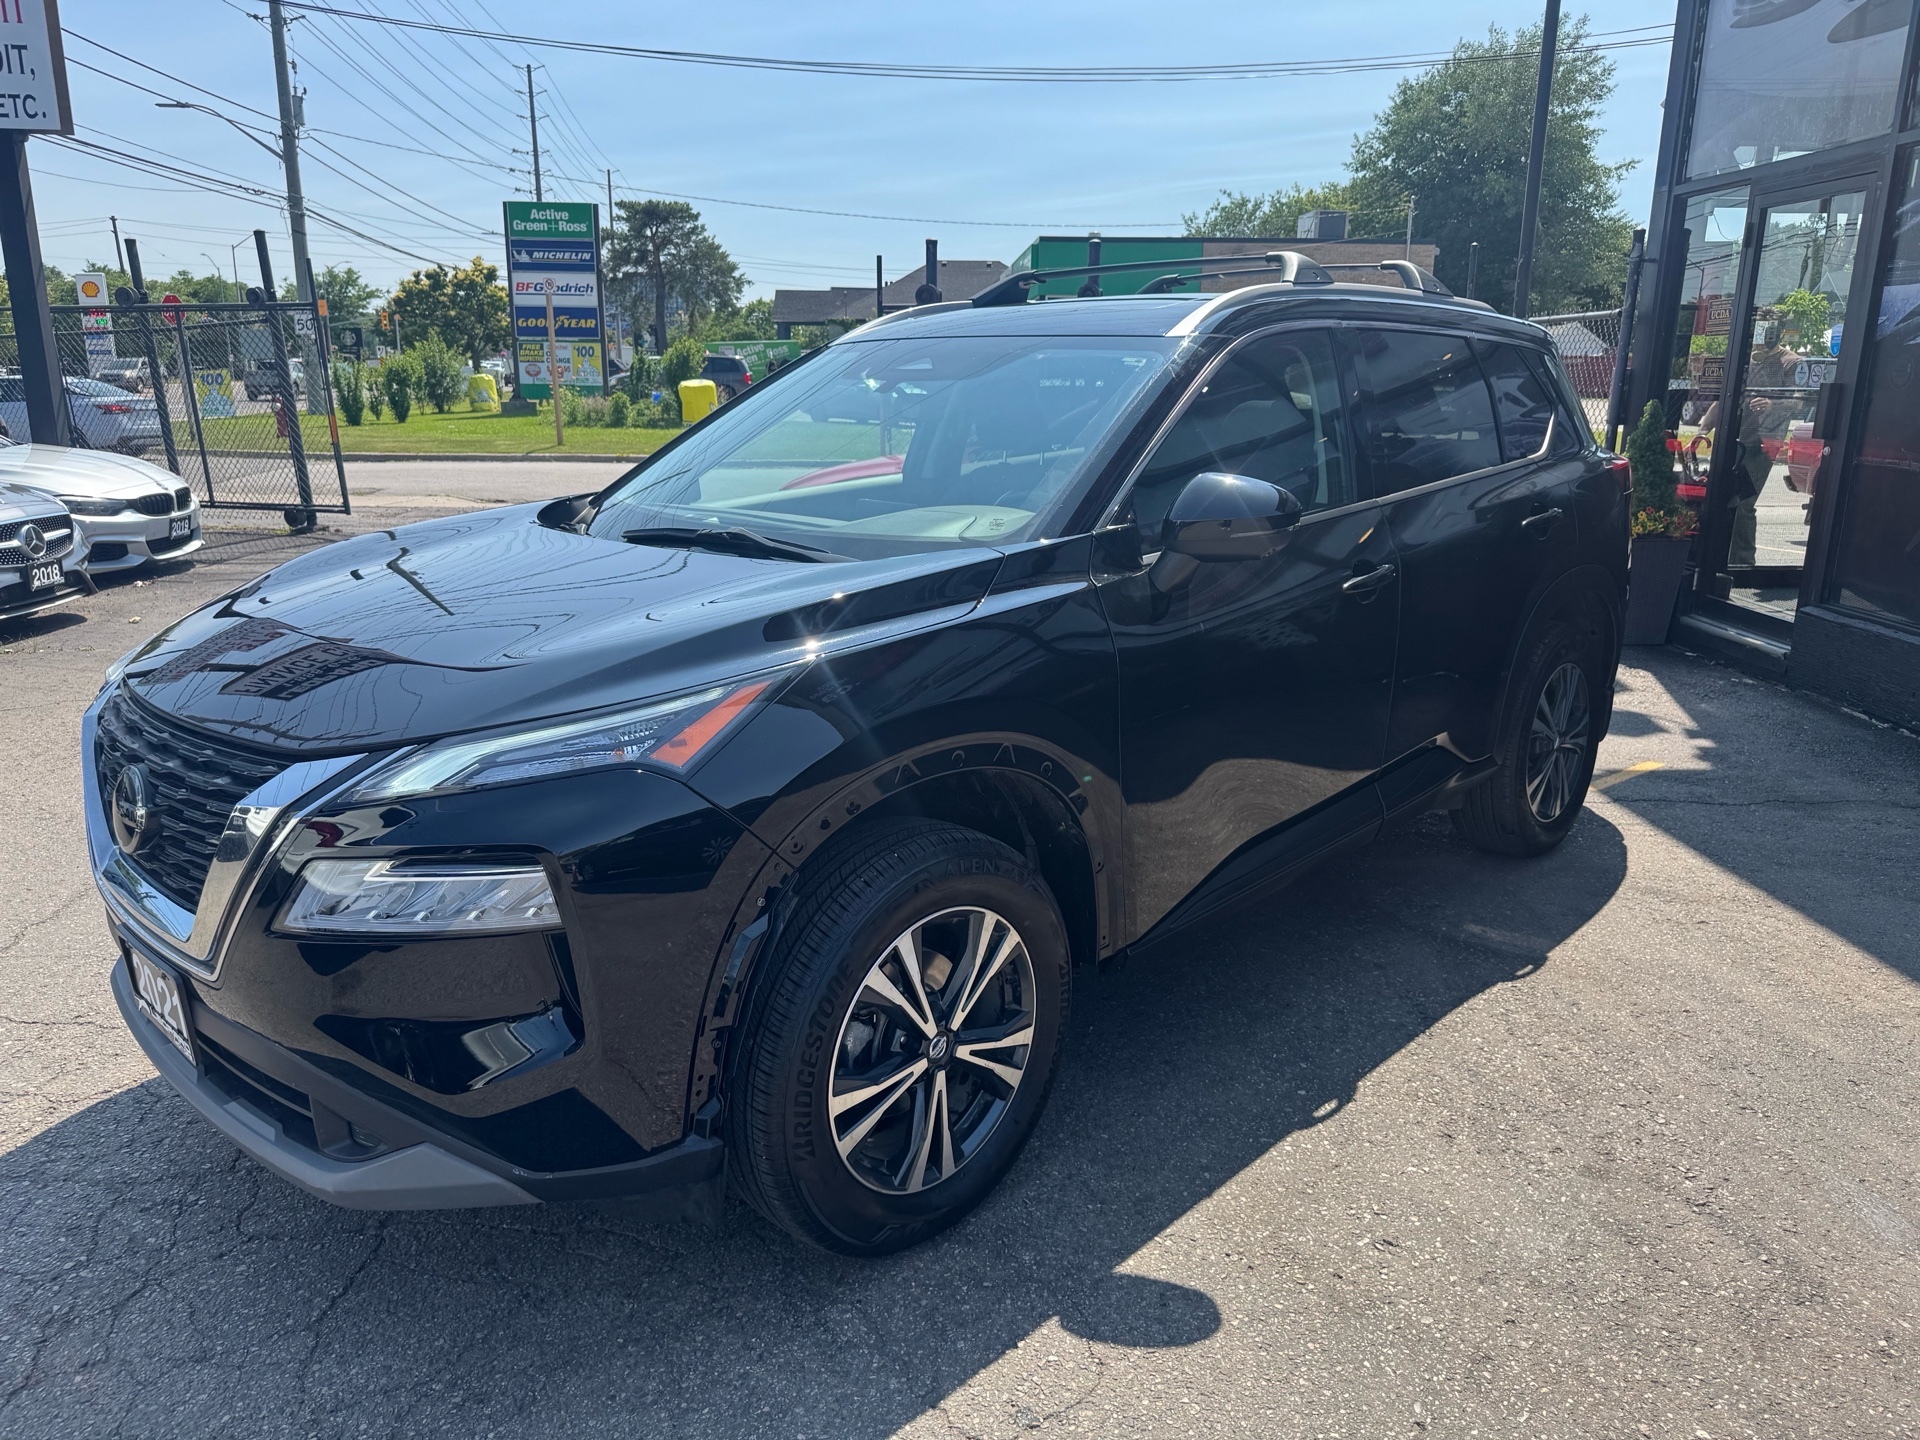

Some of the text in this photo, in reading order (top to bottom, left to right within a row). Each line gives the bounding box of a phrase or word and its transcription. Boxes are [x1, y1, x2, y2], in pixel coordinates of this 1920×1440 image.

[0, 44, 36, 81] IT,
[530, 209, 569, 220] Active
[532, 251, 591, 260] MICHELIN
[297, 318, 314, 331] 50
[517, 316, 596, 329] GOOYEAR
[171, 519, 189, 534] 2019
[32, 564, 60, 584] 2018
[132, 953, 189, 1040] 2021
[793, 957, 854, 1161] BRIDGESTONE
